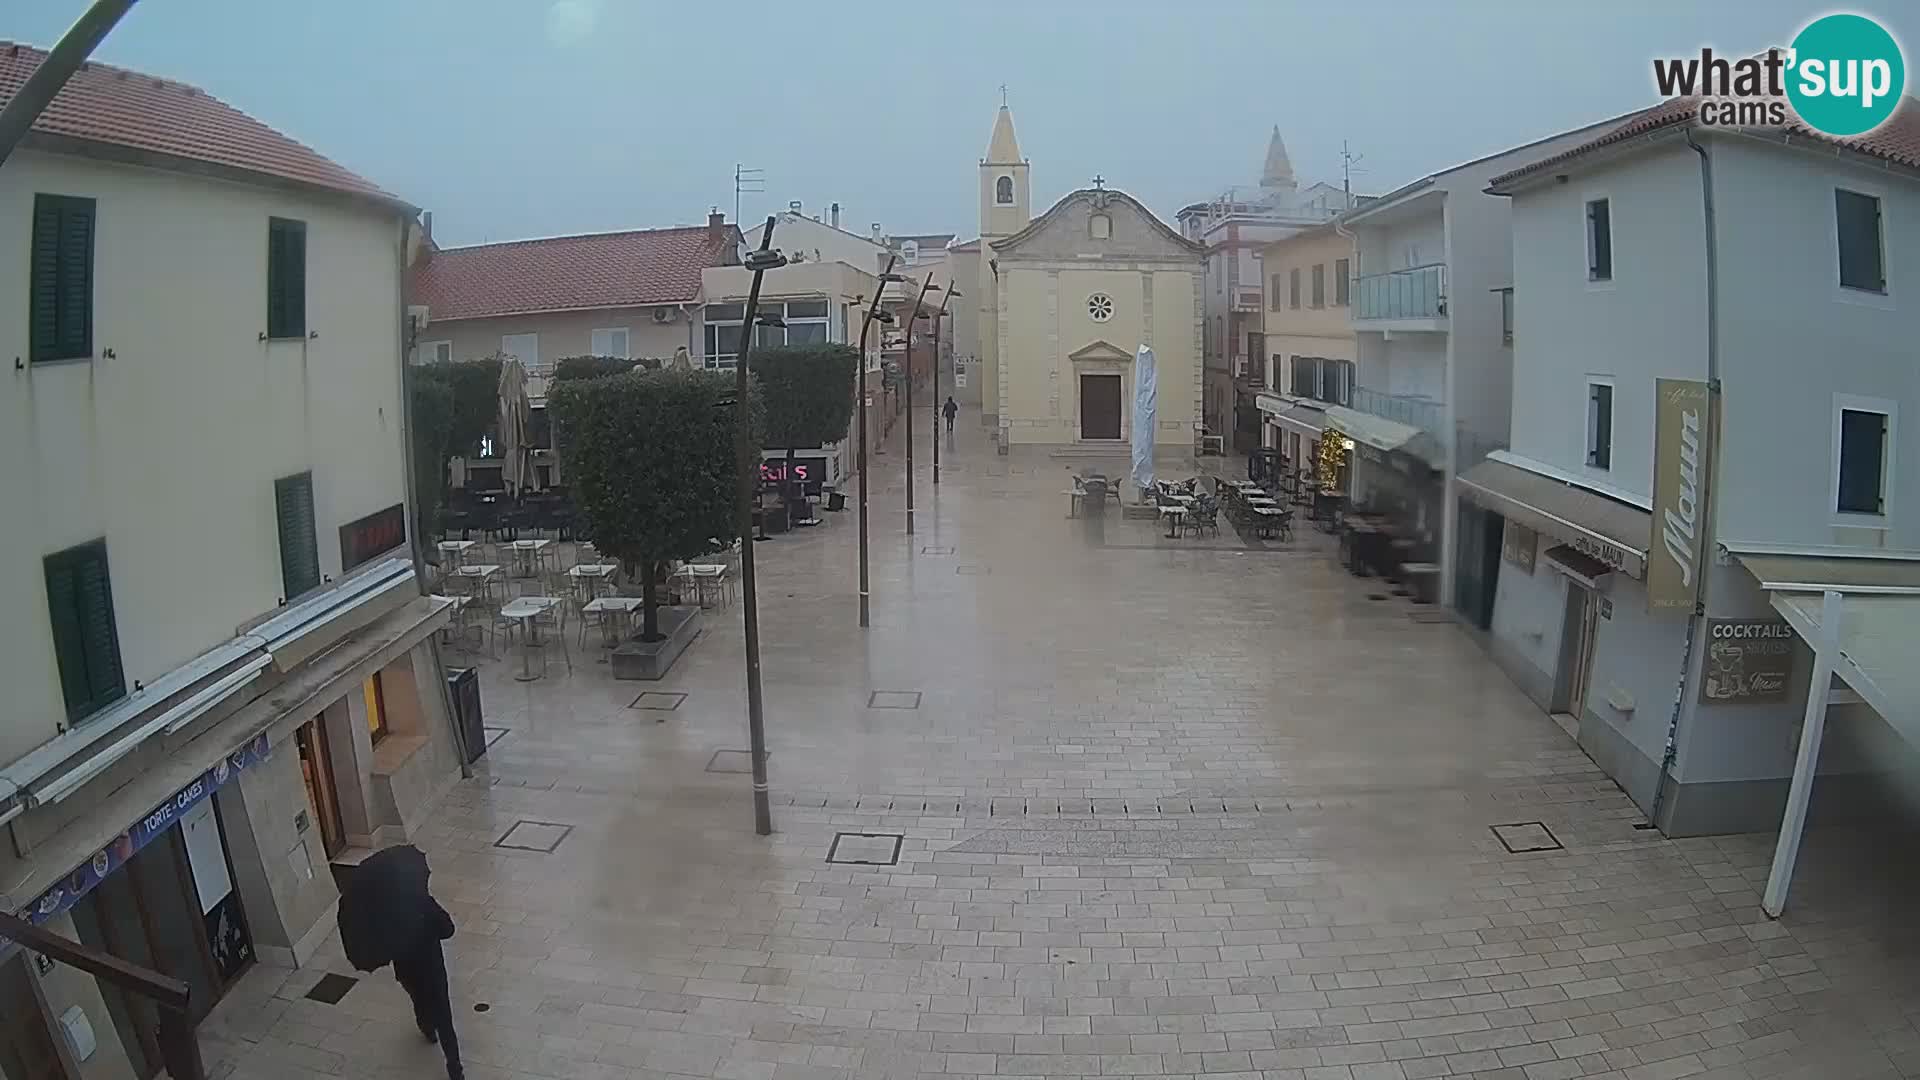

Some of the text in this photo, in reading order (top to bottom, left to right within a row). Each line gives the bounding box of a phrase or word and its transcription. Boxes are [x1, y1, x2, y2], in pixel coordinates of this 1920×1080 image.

[1712, 624, 1793, 639] COCKTAILS
[144, 803, 173, 833] TORTE
[177, 780, 203, 809] CAKES
